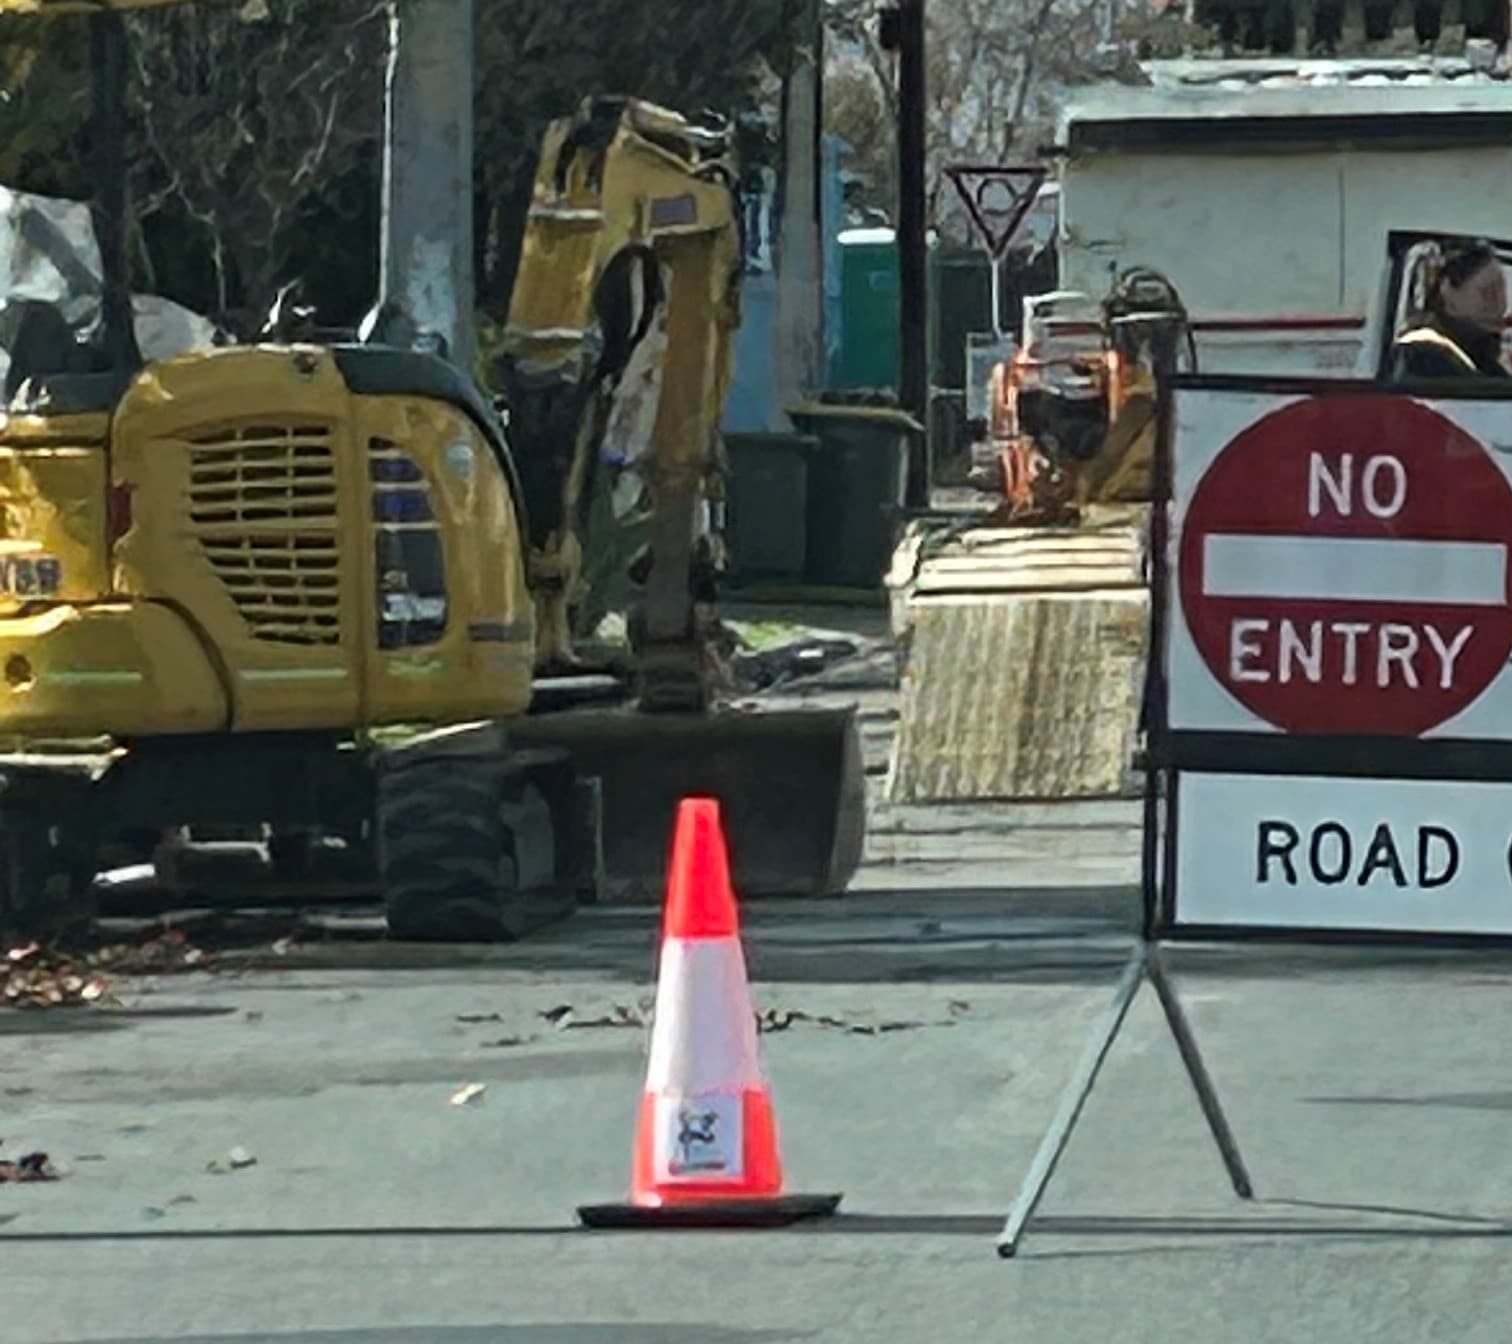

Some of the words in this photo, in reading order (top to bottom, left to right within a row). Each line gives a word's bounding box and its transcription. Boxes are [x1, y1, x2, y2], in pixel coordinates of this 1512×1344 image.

[1308, 451, 1407, 518] NO
[1230, 619, 1474, 689] ENTRY
[1256, 820, 1459, 889] ROAD
